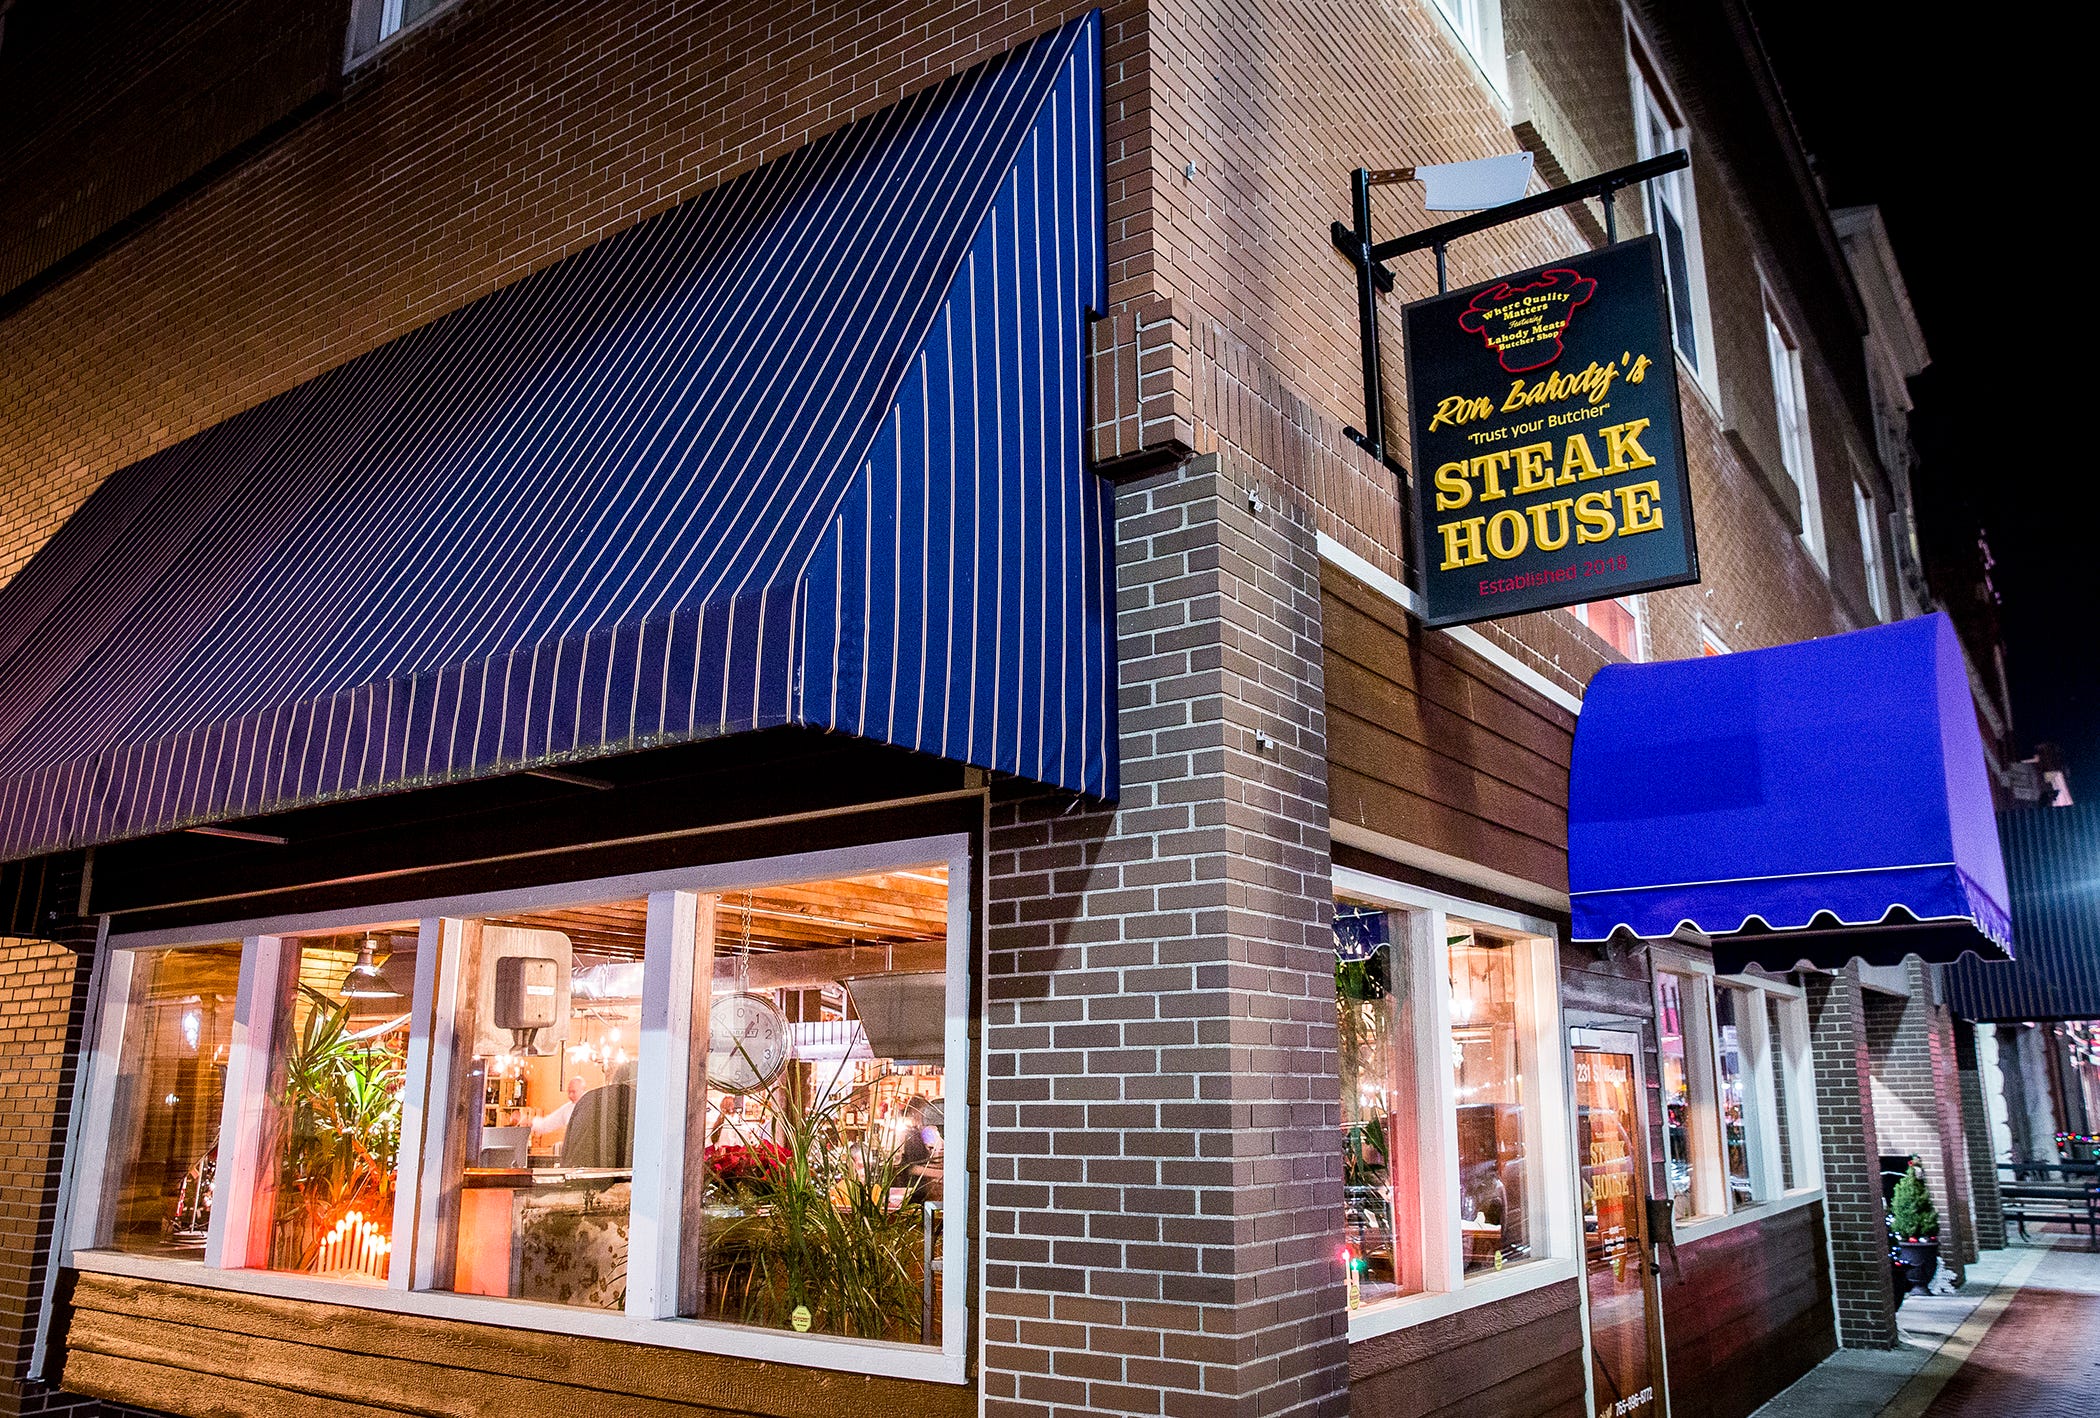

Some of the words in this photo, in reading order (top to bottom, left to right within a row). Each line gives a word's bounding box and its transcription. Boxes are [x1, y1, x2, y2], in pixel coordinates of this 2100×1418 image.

[1482, 300, 1521, 321] Where
[1522, 292, 1570, 306] Quality
[1503, 303, 1549, 321] Matters
[1487, 329, 1529, 346] Lahody
[1532, 319, 1566, 334] Meats
[1508, 314, 1543, 329] Featuring
[1498, 337, 1534, 351] Butcher
[1536, 330, 1559, 341] Shop
[1428, 395, 1495, 432] Ron
[1467, 428, 1508, 446] "Trust
[1511, 419, 1545, 439] your
[1548, 402, 1611, 428] Butcher"
[1434, 417, 1656, 512] STEAK
[1437, 480, 1664, 571] HOUSE
[1479, 564, 1577, 597] Established
[1583, 555, 1628, 578] 2018
[765, 1029, 773, 1040] 2
[764, 1049, 772, 1060] 3
[1577, 1063, 1591, 1083] 231
[1592, 1171, 1629, 1201] HOUSE
